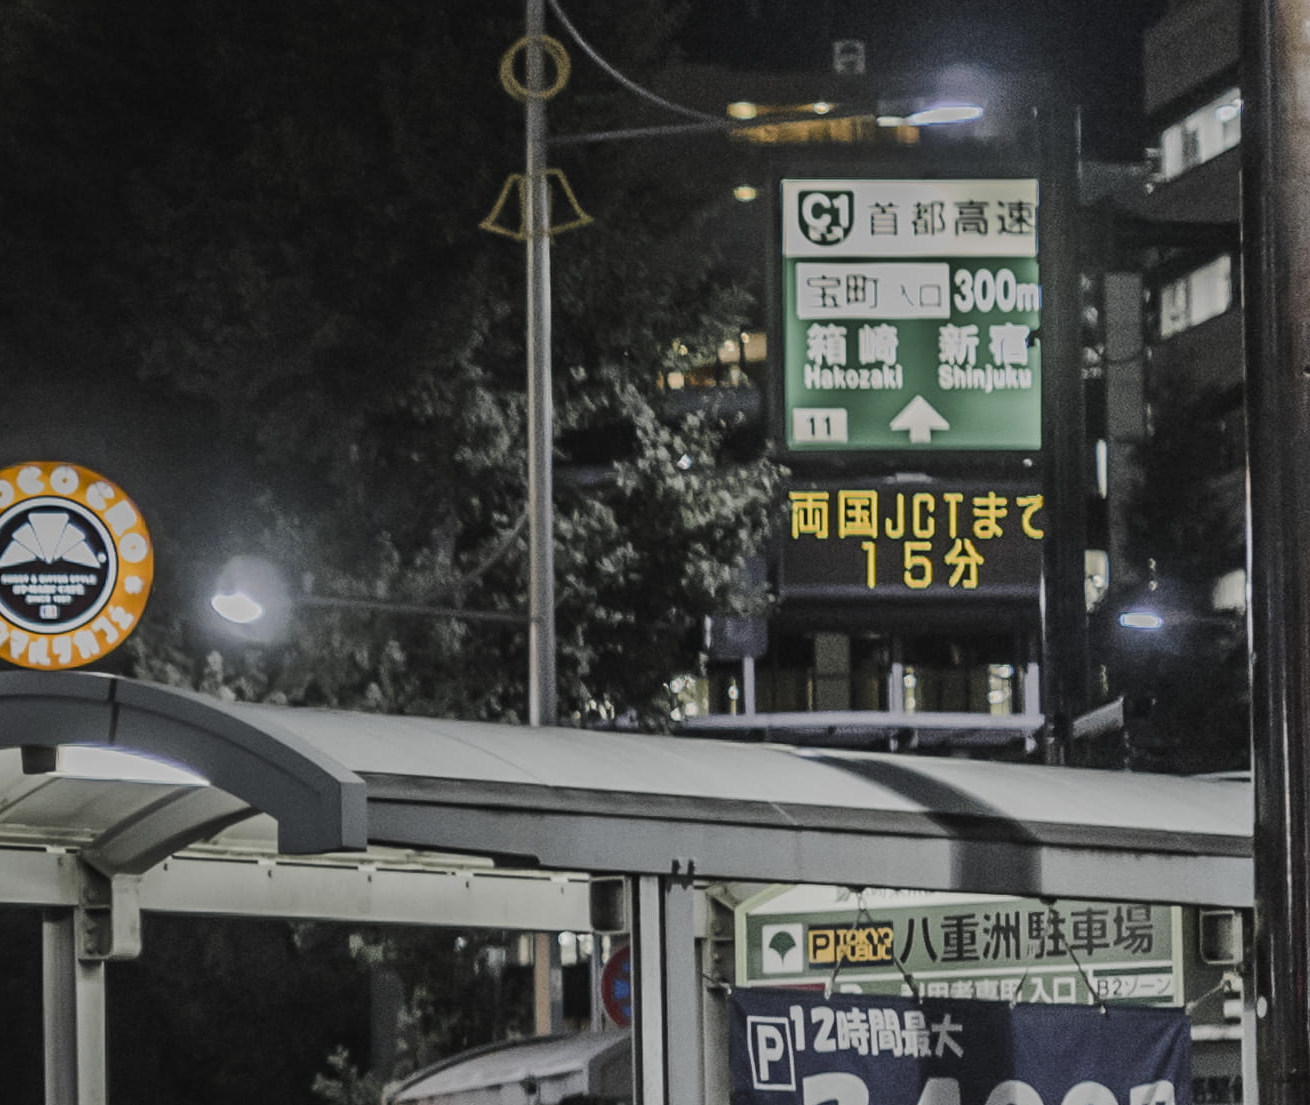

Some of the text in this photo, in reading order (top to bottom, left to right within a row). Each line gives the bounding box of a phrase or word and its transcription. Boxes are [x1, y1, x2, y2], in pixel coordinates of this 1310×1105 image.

[802, 192, 849, 229] C1
[869, 200, 1037, 237] 首都高速
[954, 268, 1041, 313] 300m
[806, 323, 899, 365] 箱崎
[939, 322, 1030, 365] 新宿
[804, 364, 904, 389] Hakozaki
[938, 364, 1032, 393] Shinjuku
[807, 417, 832, 437] 11
[789, 489, 1045, 539] 両国JCTまで
[861, 538, 985, 589] 15分
[836, 927, 894, 946] TOKYO
[836, 944, 893, 962] PUBLIC
[900, 903, 1154, 964] 八重洲駐車場
[789, 1004, 964, 1059] 12時間最大
